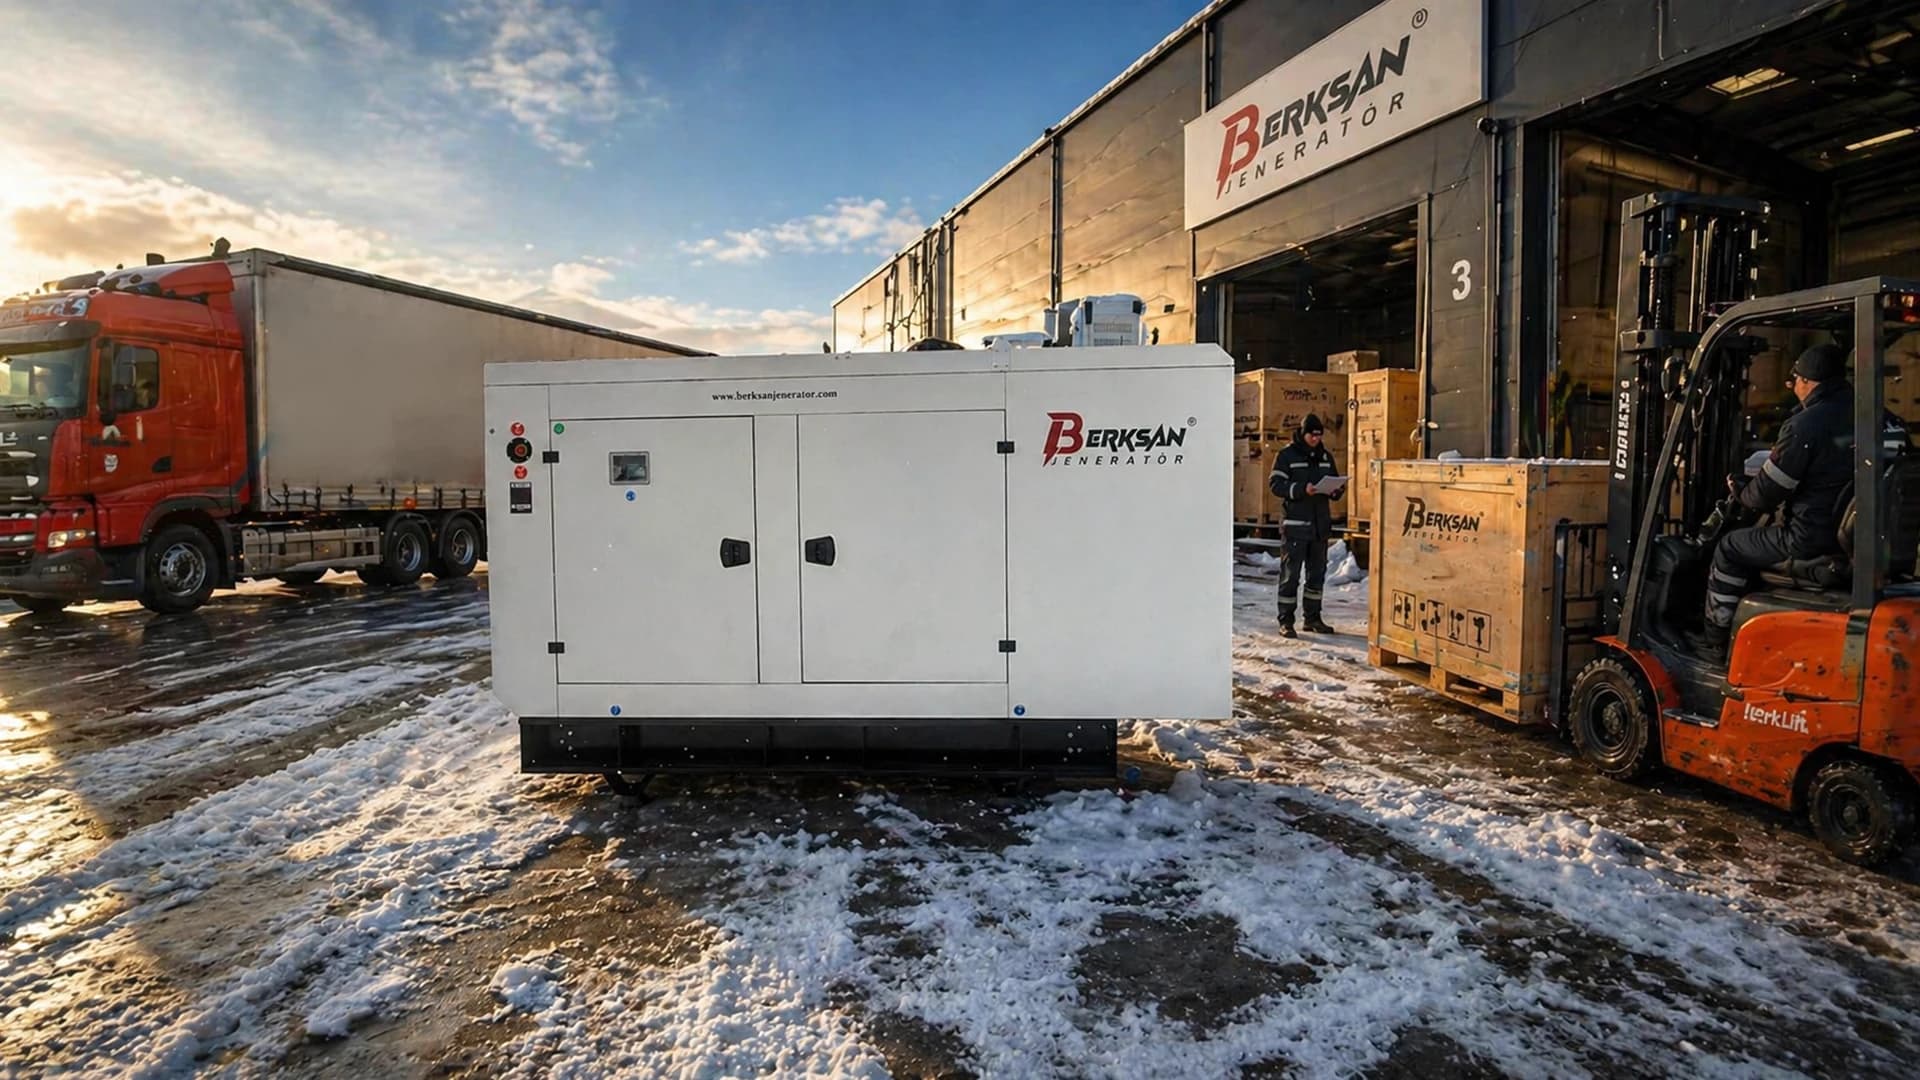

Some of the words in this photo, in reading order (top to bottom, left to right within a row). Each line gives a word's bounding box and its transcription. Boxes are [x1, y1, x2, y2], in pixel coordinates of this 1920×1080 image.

[1216, 35, 1410, 199] BERKSAN
[1451, 259, 1471, 300] 3
[712, 390, 838, 401] www.berksanjenerator.com
[1043, 412, 1187, 467] BERKSAN
[1402, 496, 1480, 536] BERKSAN
